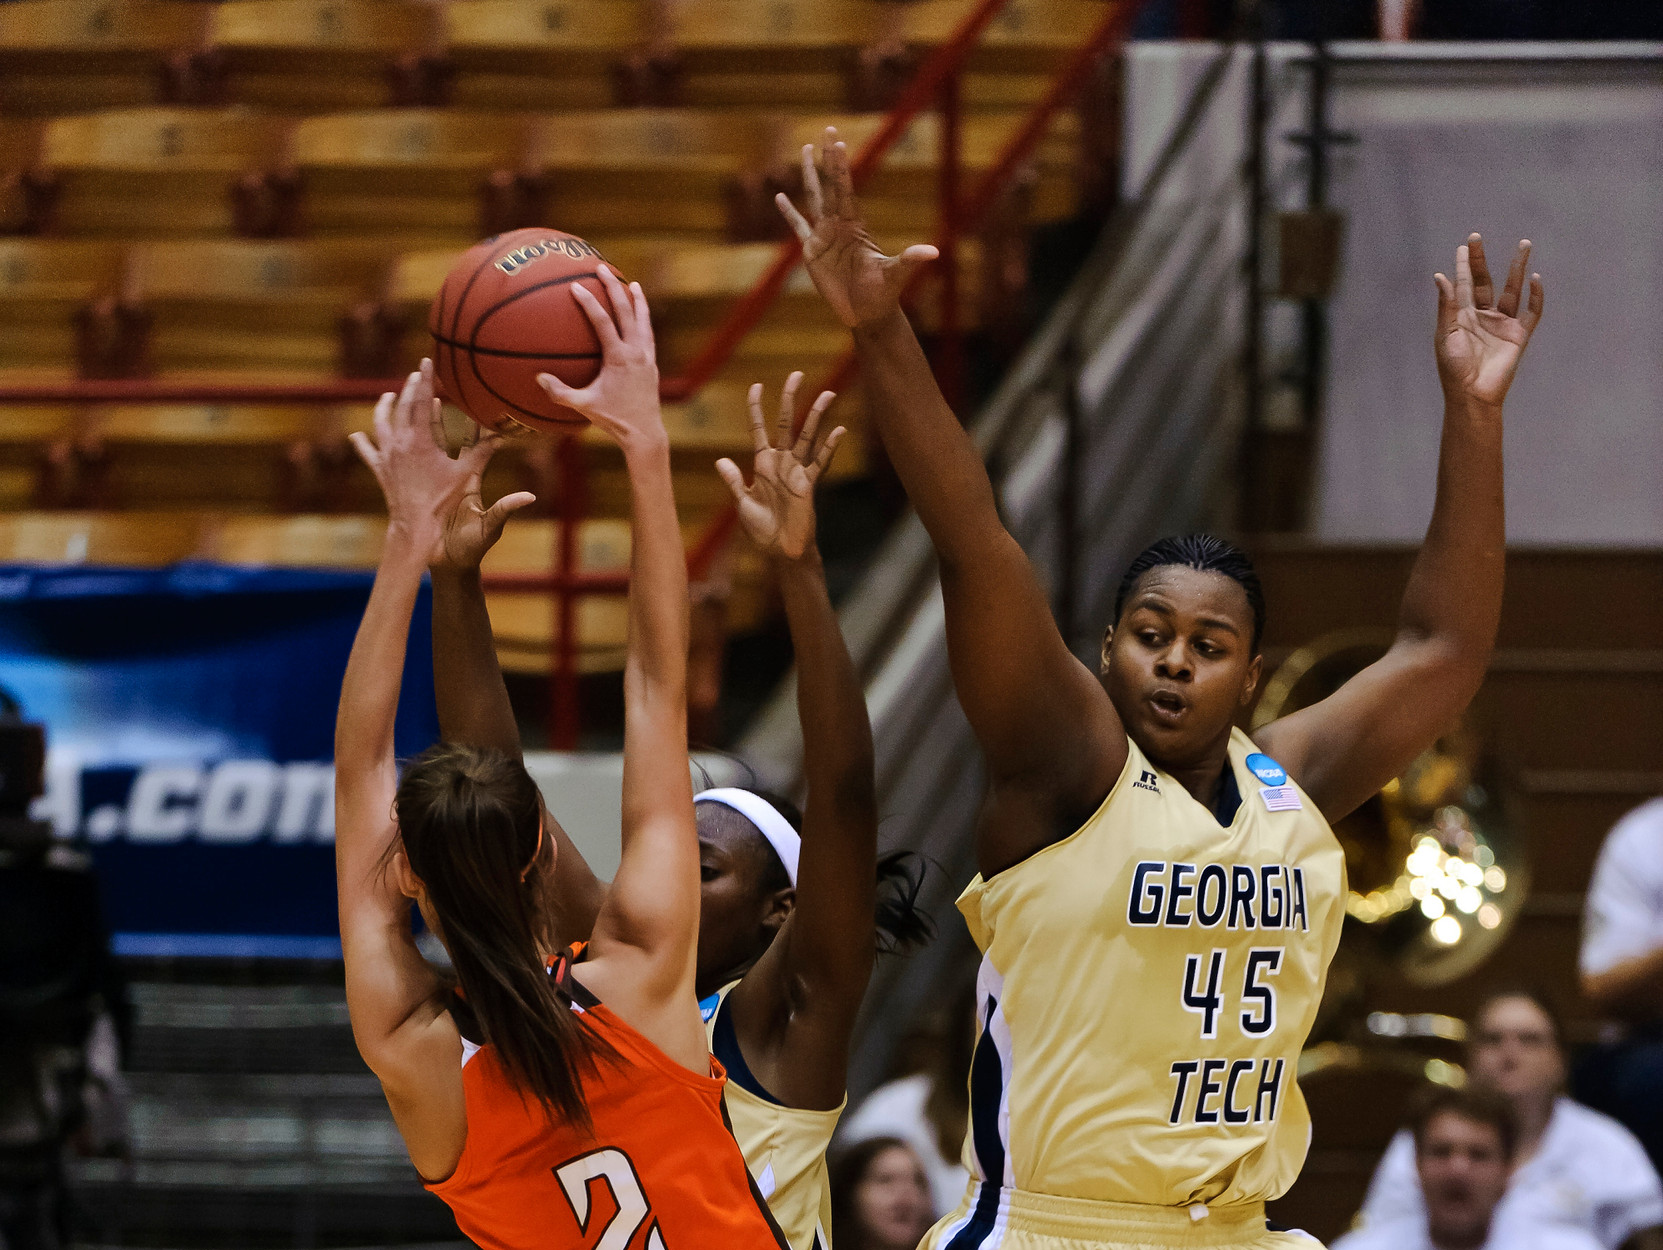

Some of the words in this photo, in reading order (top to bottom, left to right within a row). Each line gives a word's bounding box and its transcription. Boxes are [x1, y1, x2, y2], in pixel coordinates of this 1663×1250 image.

[1127, 860, 1309, 932] GEORGIA
[1181, 947, 1285, 1039] 45
[1168, 1058, 1285, 1126] TECH
